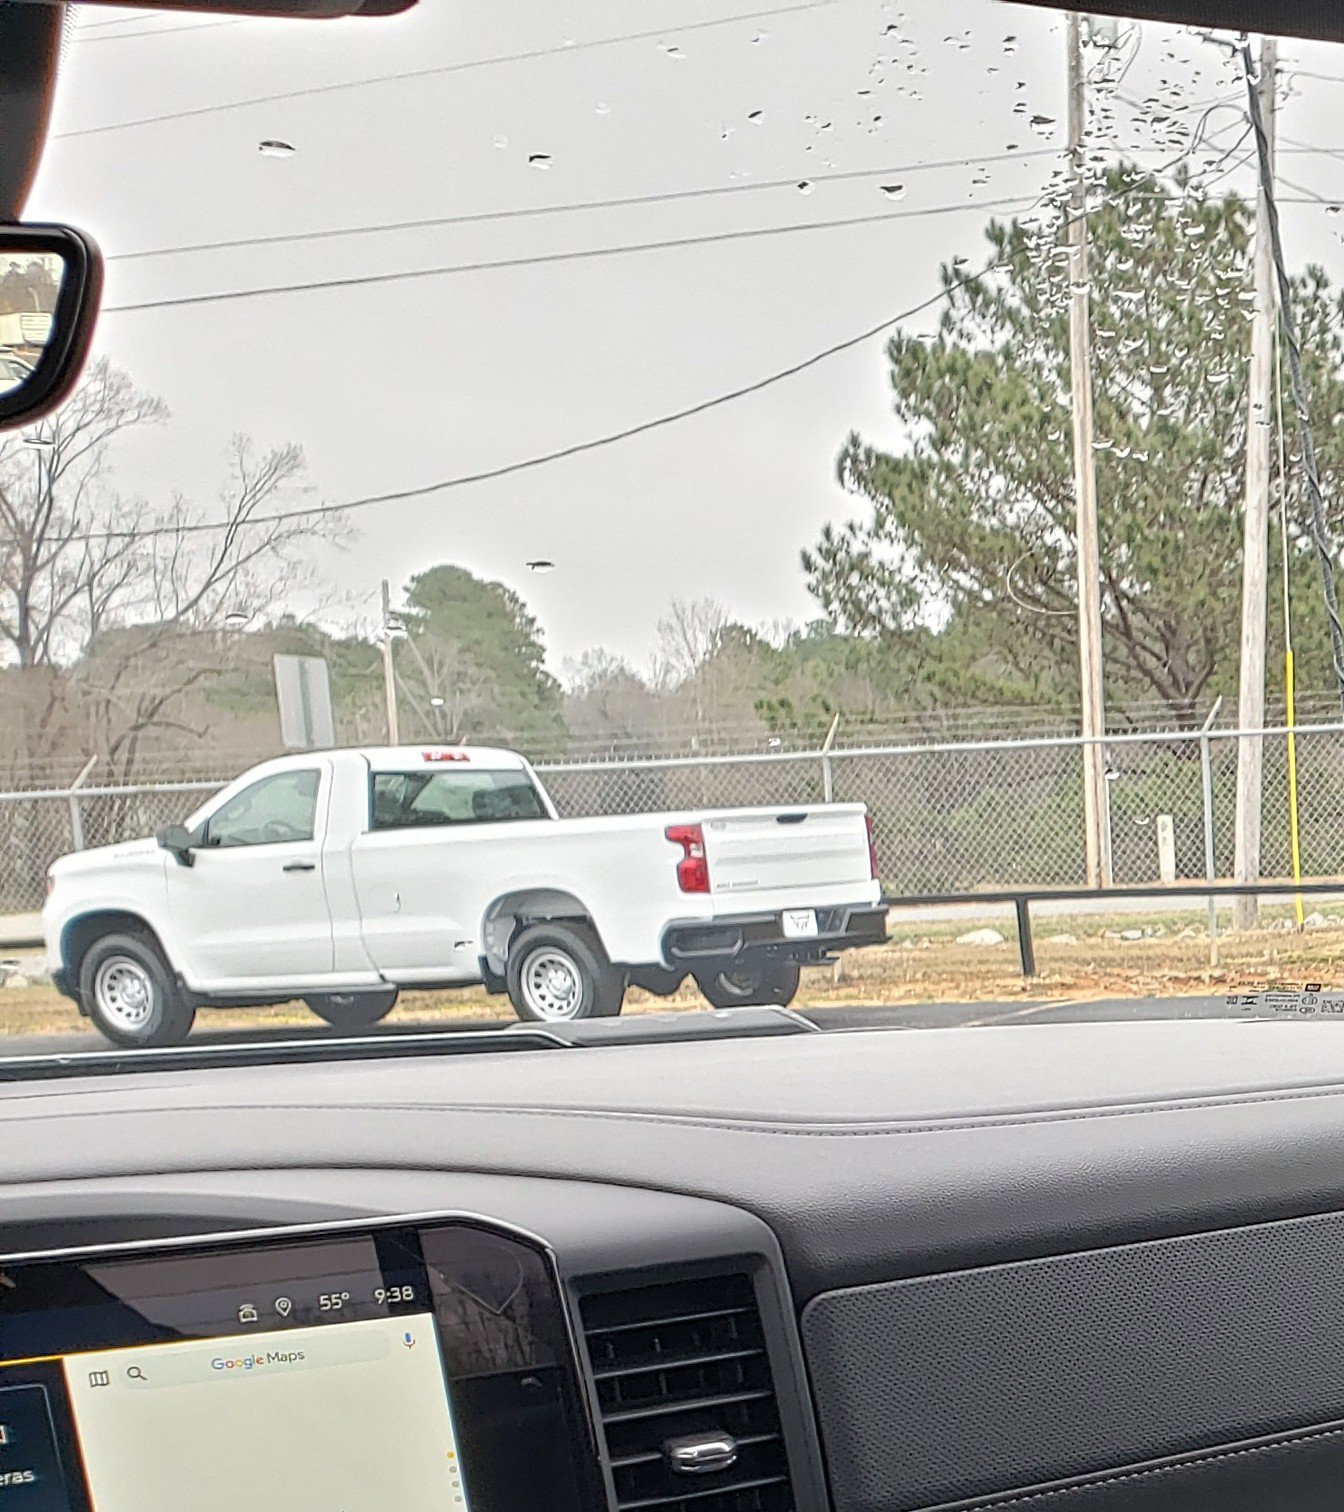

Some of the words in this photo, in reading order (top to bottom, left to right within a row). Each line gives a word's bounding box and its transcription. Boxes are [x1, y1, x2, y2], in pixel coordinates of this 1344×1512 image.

[374, 1285, 414, 1305] 9:38
[211, 1354, 265, 1370] Google
[267, 1350, 305, 1364] Maps
